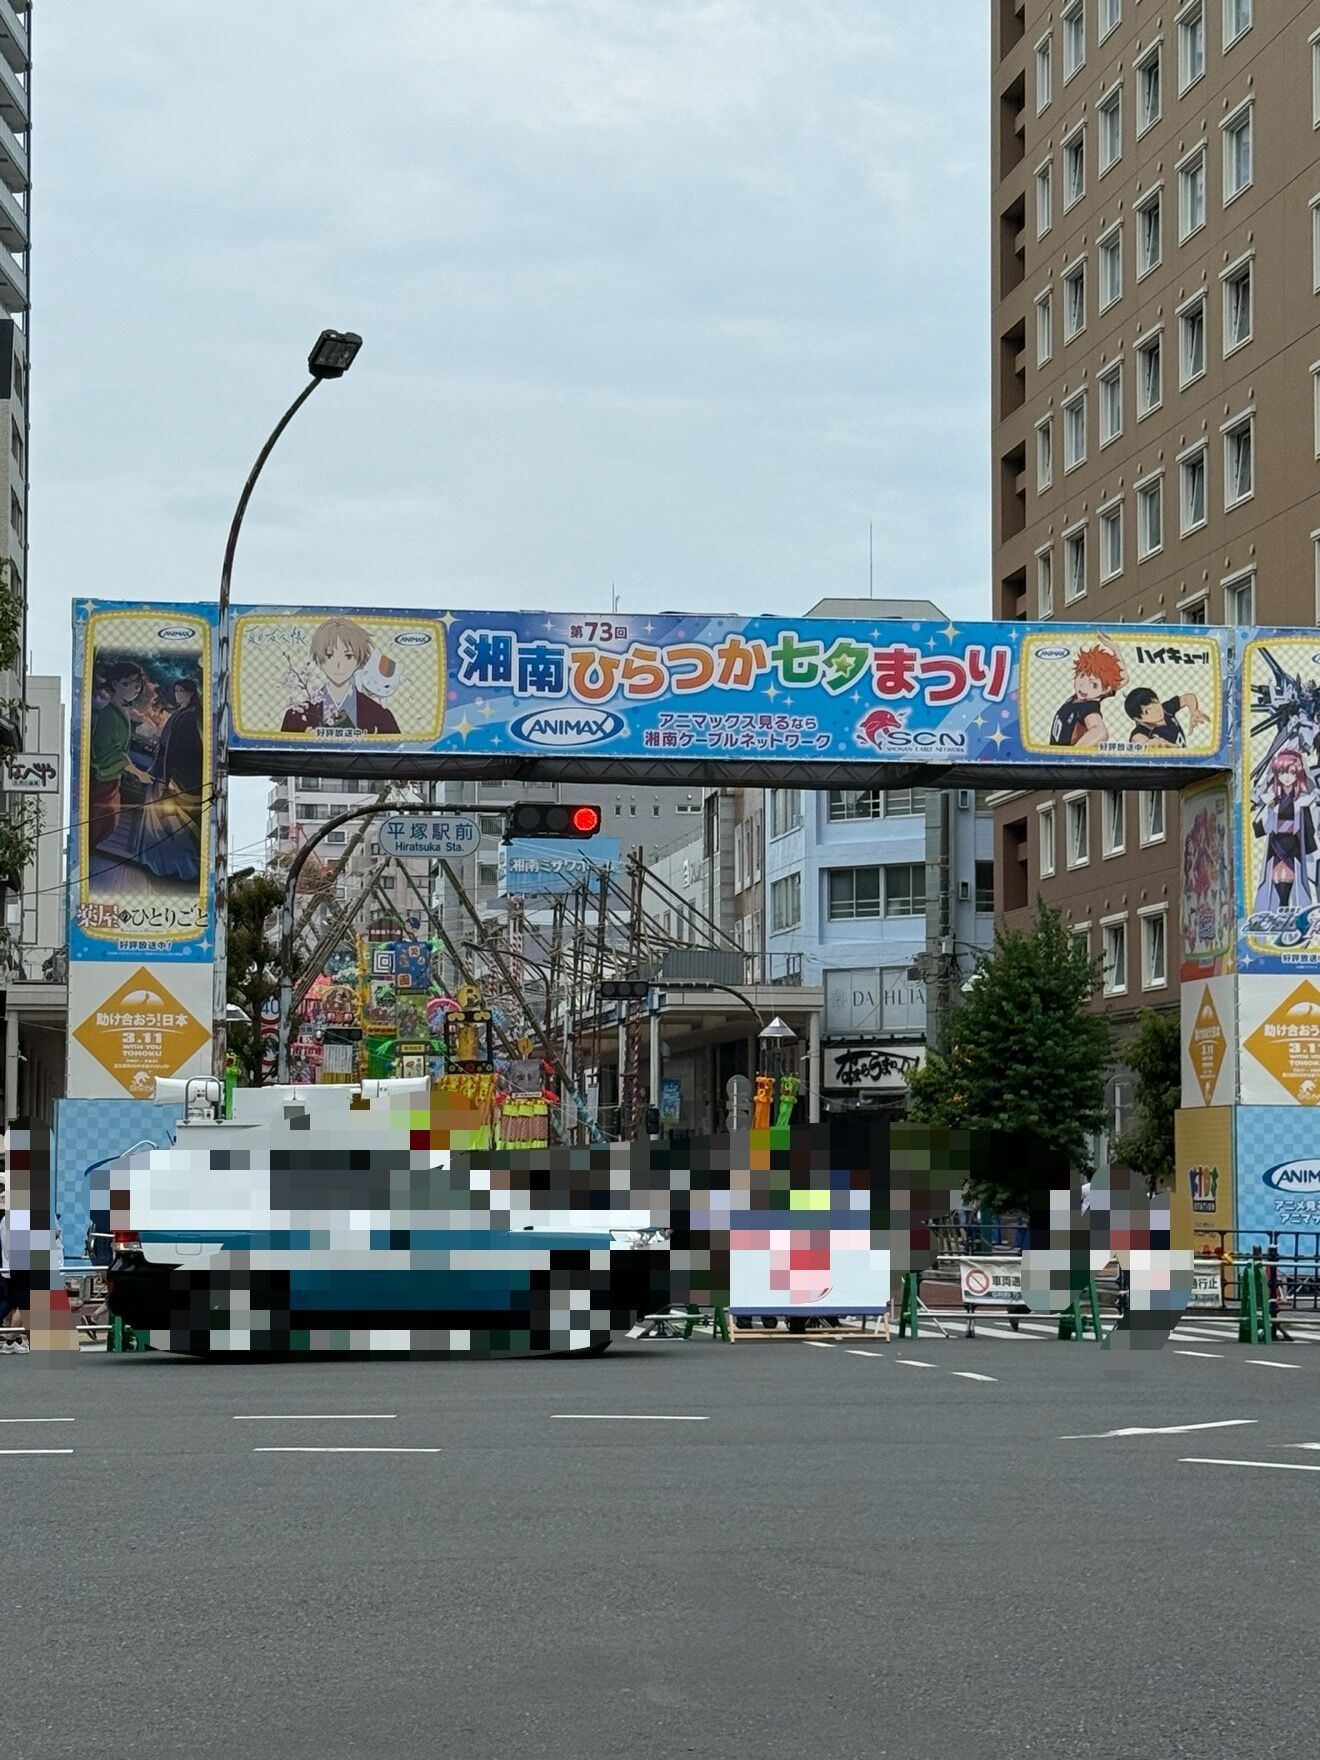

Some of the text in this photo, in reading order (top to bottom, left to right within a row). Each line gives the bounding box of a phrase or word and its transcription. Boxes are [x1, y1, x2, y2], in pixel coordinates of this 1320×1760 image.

[570, 622, 628, 641] 第73回
[460, 632, 1009, 703] 湘南ひらつか七夕まつり
[526, 718, 611, 738] ANIMAX
[659, 713, 818, 730] アニマックス見るなら
[645, 731, 831, 748] 湘南ケーブルネットワーク
[887, 731, 966, 747] SCN
[5, 762, 57, 787] なべや
[387, 822, 473, 840] 平塚駅前
[395, 841, 441, 852] Hiratsuka
[77, 901, 209, 929] 薬屋のひとりごと
[853, 990, 926, 1007] DAHLIA
[96, 1012, 189, 1027] 助け合おう!日本
[122, 1032, 162, 1044] 3.11
